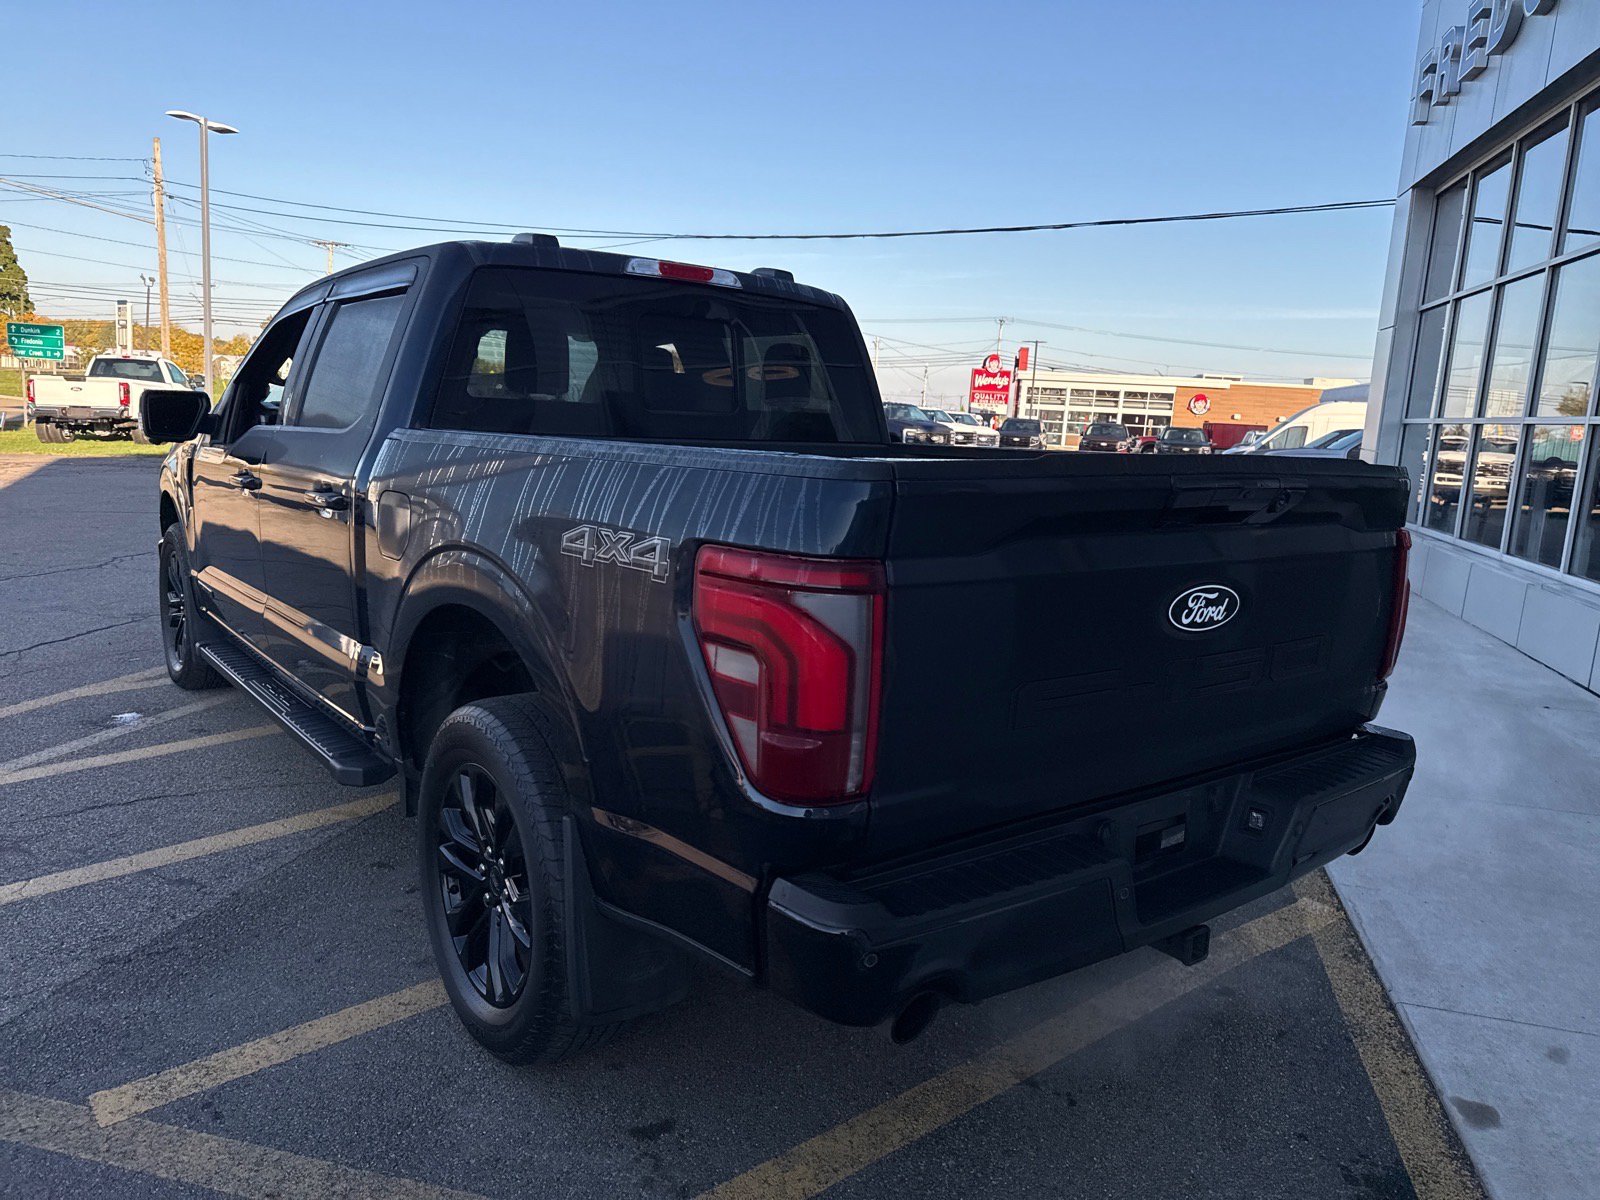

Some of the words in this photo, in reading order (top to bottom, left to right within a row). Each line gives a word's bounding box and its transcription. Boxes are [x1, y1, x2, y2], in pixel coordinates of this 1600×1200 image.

[20, 337, 43, 345] Fredonia
[29, 349, 44, 357] Creek
[975, 373, 1009, 388] Wendy's
[1181, 592, 1229, 625] Ford
